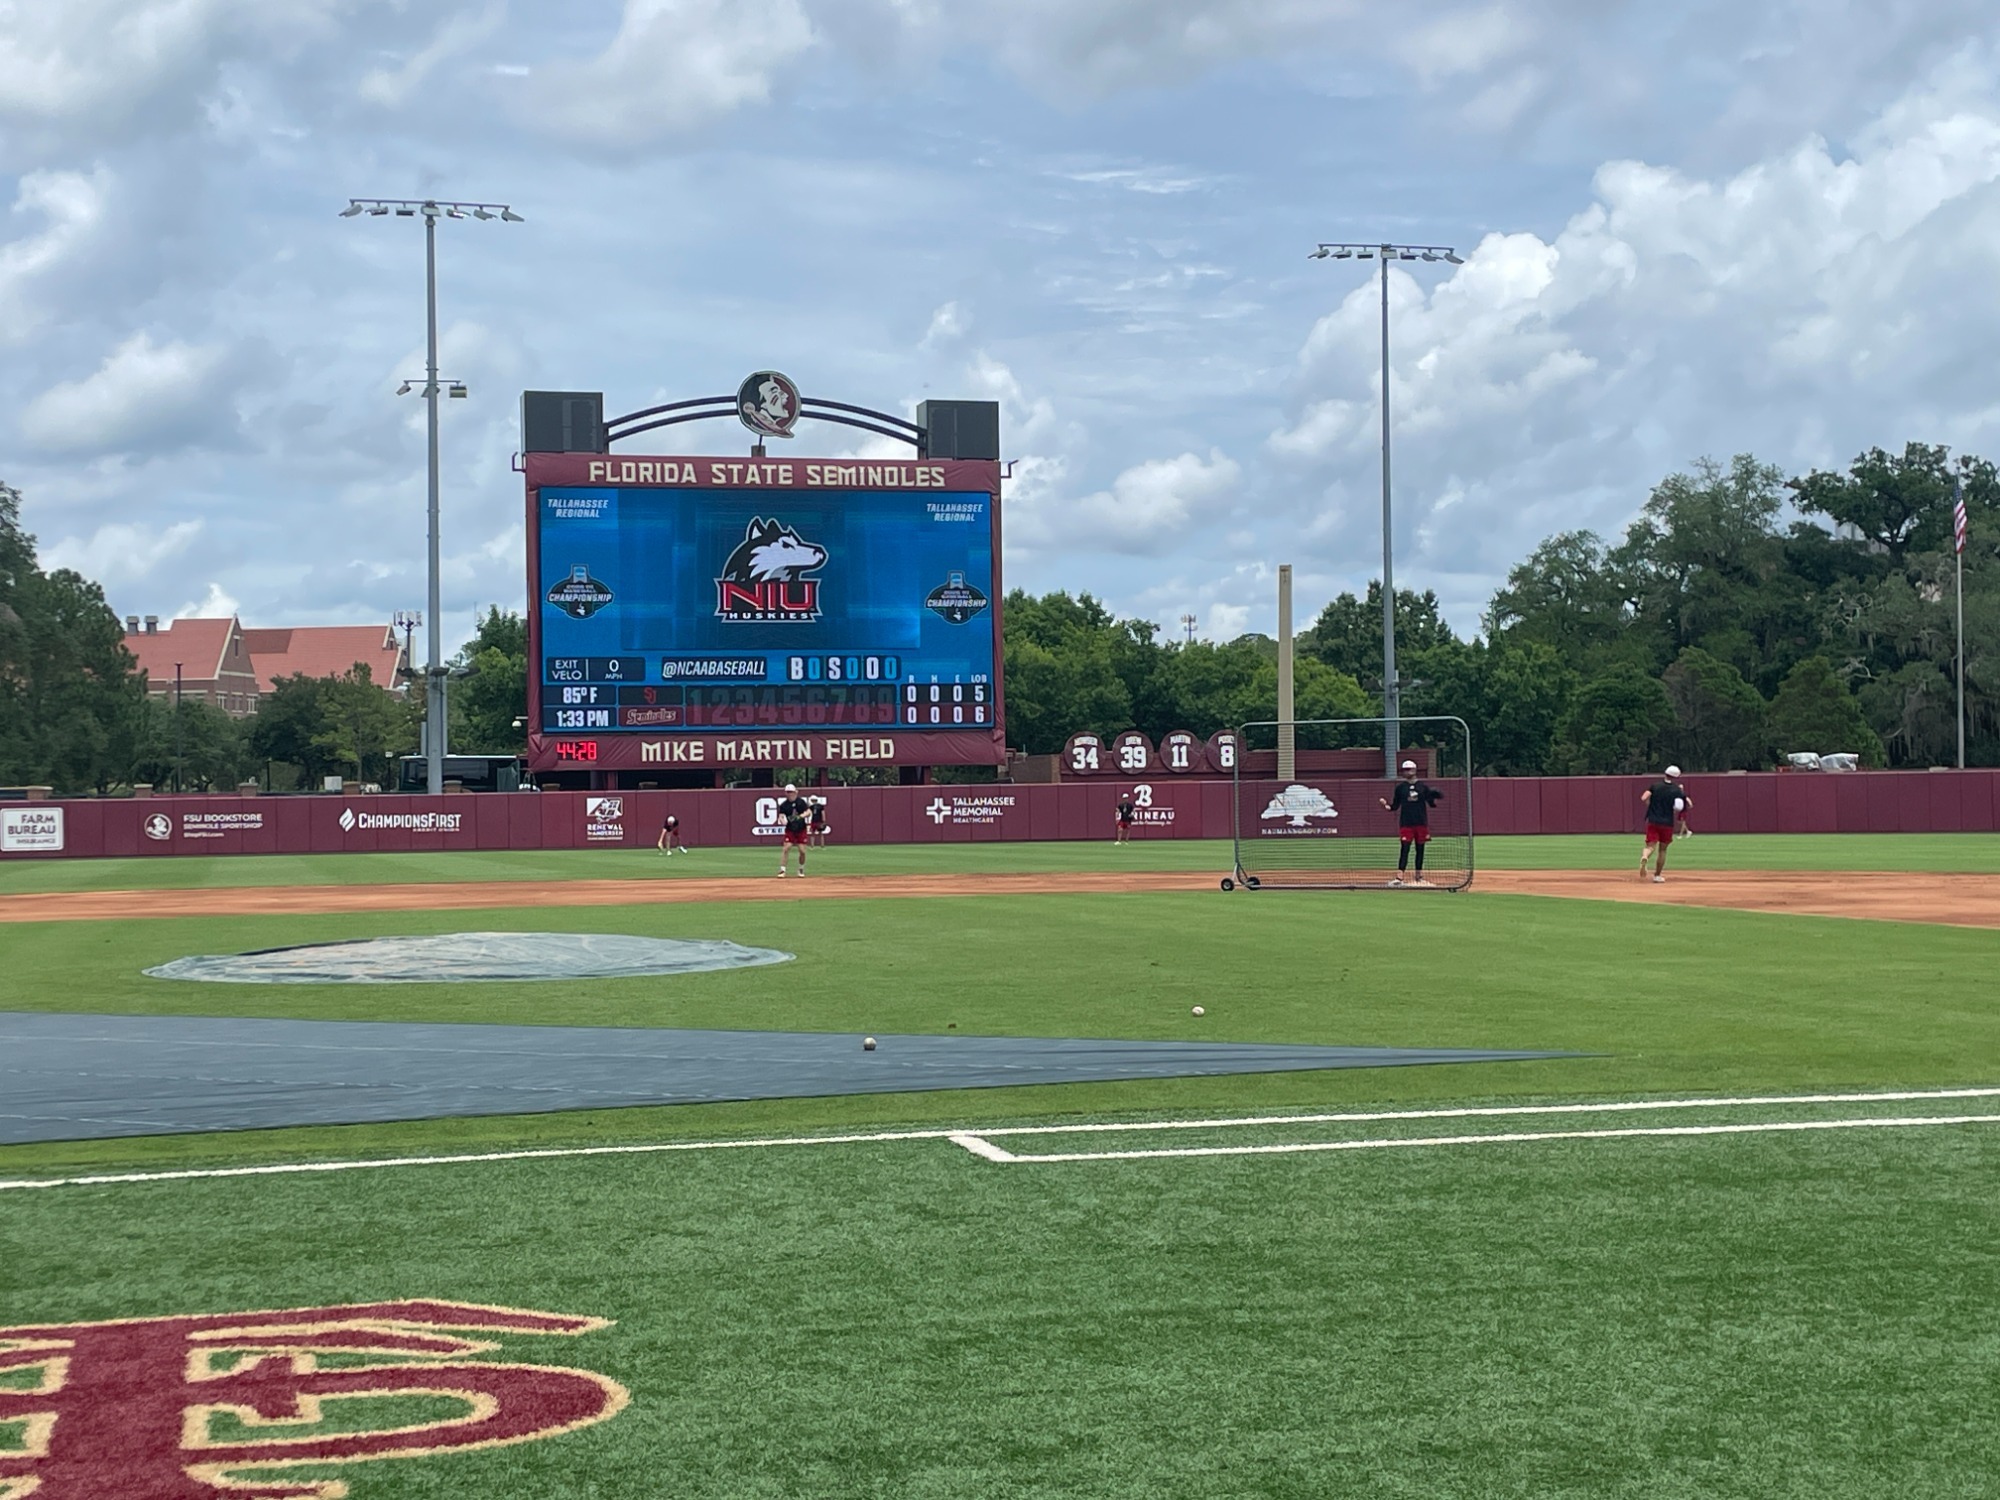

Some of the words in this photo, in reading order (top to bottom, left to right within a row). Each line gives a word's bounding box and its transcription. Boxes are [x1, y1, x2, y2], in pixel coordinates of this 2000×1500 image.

[589, 461, 697, 484] FLORIDA
[711, 463, 793, 484] STATE
[806, 465, 945, 487] SEMINOLES
[547, 498, 608, 509] TALLAHASSEE
[926, 503, 984, 512] TALLAHASSEE
[555, 508, 600, 518] REGIONAL
[934, 512, 976, 522] REGIONAL
[548, 593, 612, 602] CHAMPIONSHIP
[722, 582, 813, 610] NIU
[927, 598, 987, 608] CHAMPIONSHIP
[555, 660, 578, 670] EXIT
[608, 659, 620, 672] 0
[662, 661, 766, 678] @NCAABASEBALL
[791, 656, 804, 680] B
[828, 656, 842, 680] S
[552, 670, 582, 680] VELO
[908, 675, 915, 683] R
[954, 675, 961, 683] E
[970, 674, 988, 683] LOB
[907, 685, 918, 703] 0
[930, 685, 940, 703] 0
[953, 685, 963, 703] 0
[974, 685, 984, 702] 5
[556, 710, 584, 728] 1:33
[586, 710, 609, 727] PM
[908, 706, 918, 724] 0
[930, 706, 940, 724] 0
[954, 706, 964, 724] 0
[974, 706, 984, 724] 6
[641, 741, 704, 762] MIKE
[716, 740, 812, 761] MARTIN
[826, 739, 895, 760] FIELD
[1172, 744, 1189, 767] 11
[1220, 744, 1234, 767] 8
[1072, 747, 1099, 770] 34
[1120, 746, 1146, 768] 39
[1134, 784, 1152, 806] B
[952, 797, 1016, 806] TALLAHASSEE
[184, 814, 202, 822] FSU
[204, 813, 263, 822] BOOKSTORE
[952, 807, 1004, 816] MEMORIAL
[21, 814, 56, 824] FARM
[8, 824, 56, 835] BUREAU
